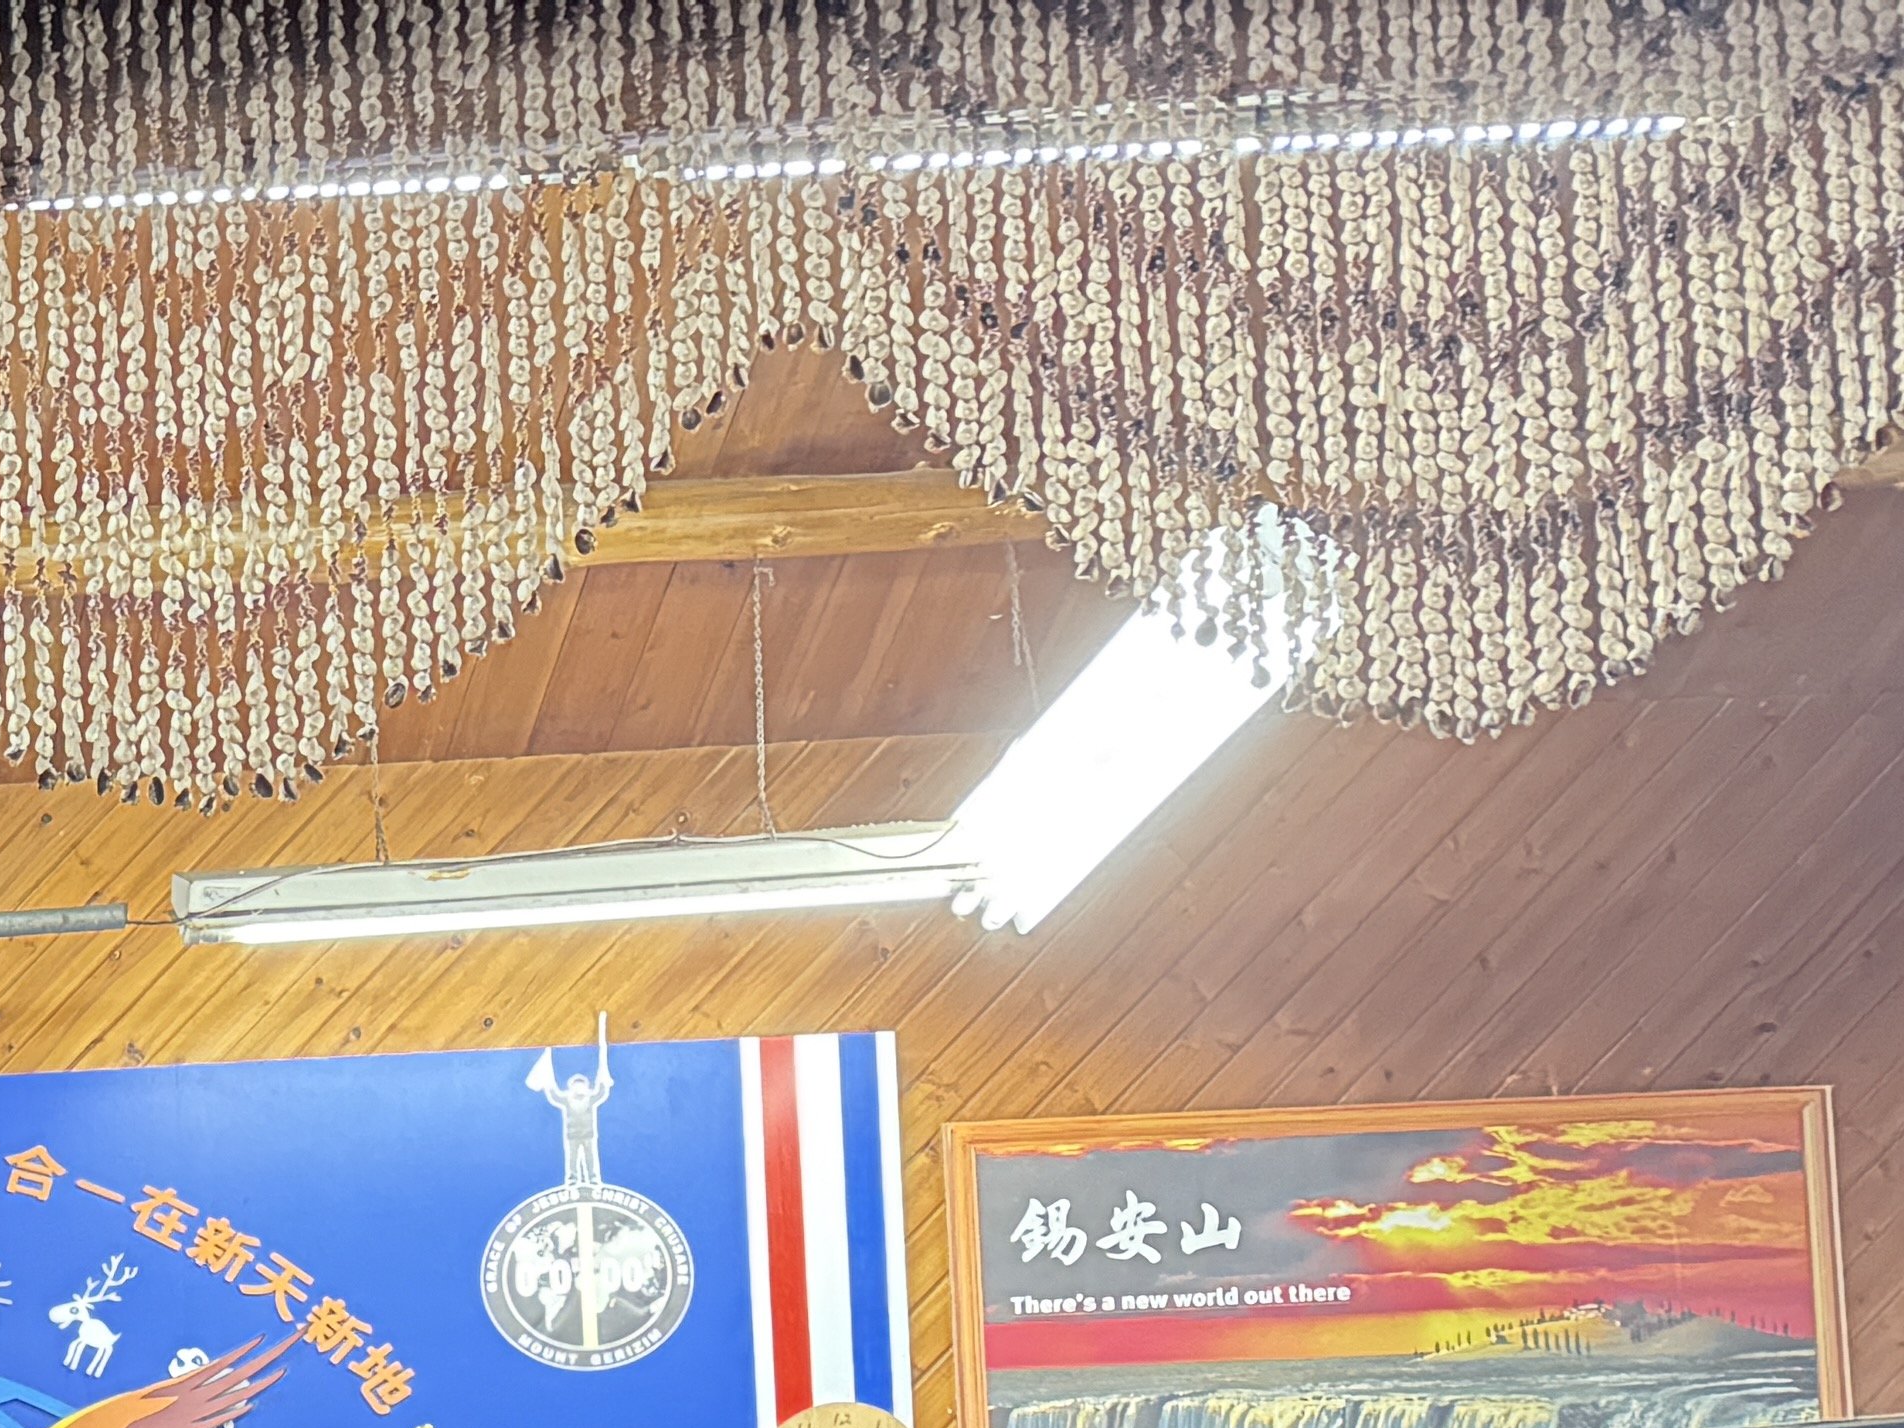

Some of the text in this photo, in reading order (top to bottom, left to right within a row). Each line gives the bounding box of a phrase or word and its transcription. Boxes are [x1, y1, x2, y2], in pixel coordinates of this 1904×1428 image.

[1009, 1189, 1243, 1267] 錫安山
[1009, 1283, 1352, 1316] There's a new world out there
[833, 1412, 852, 1426] 12
